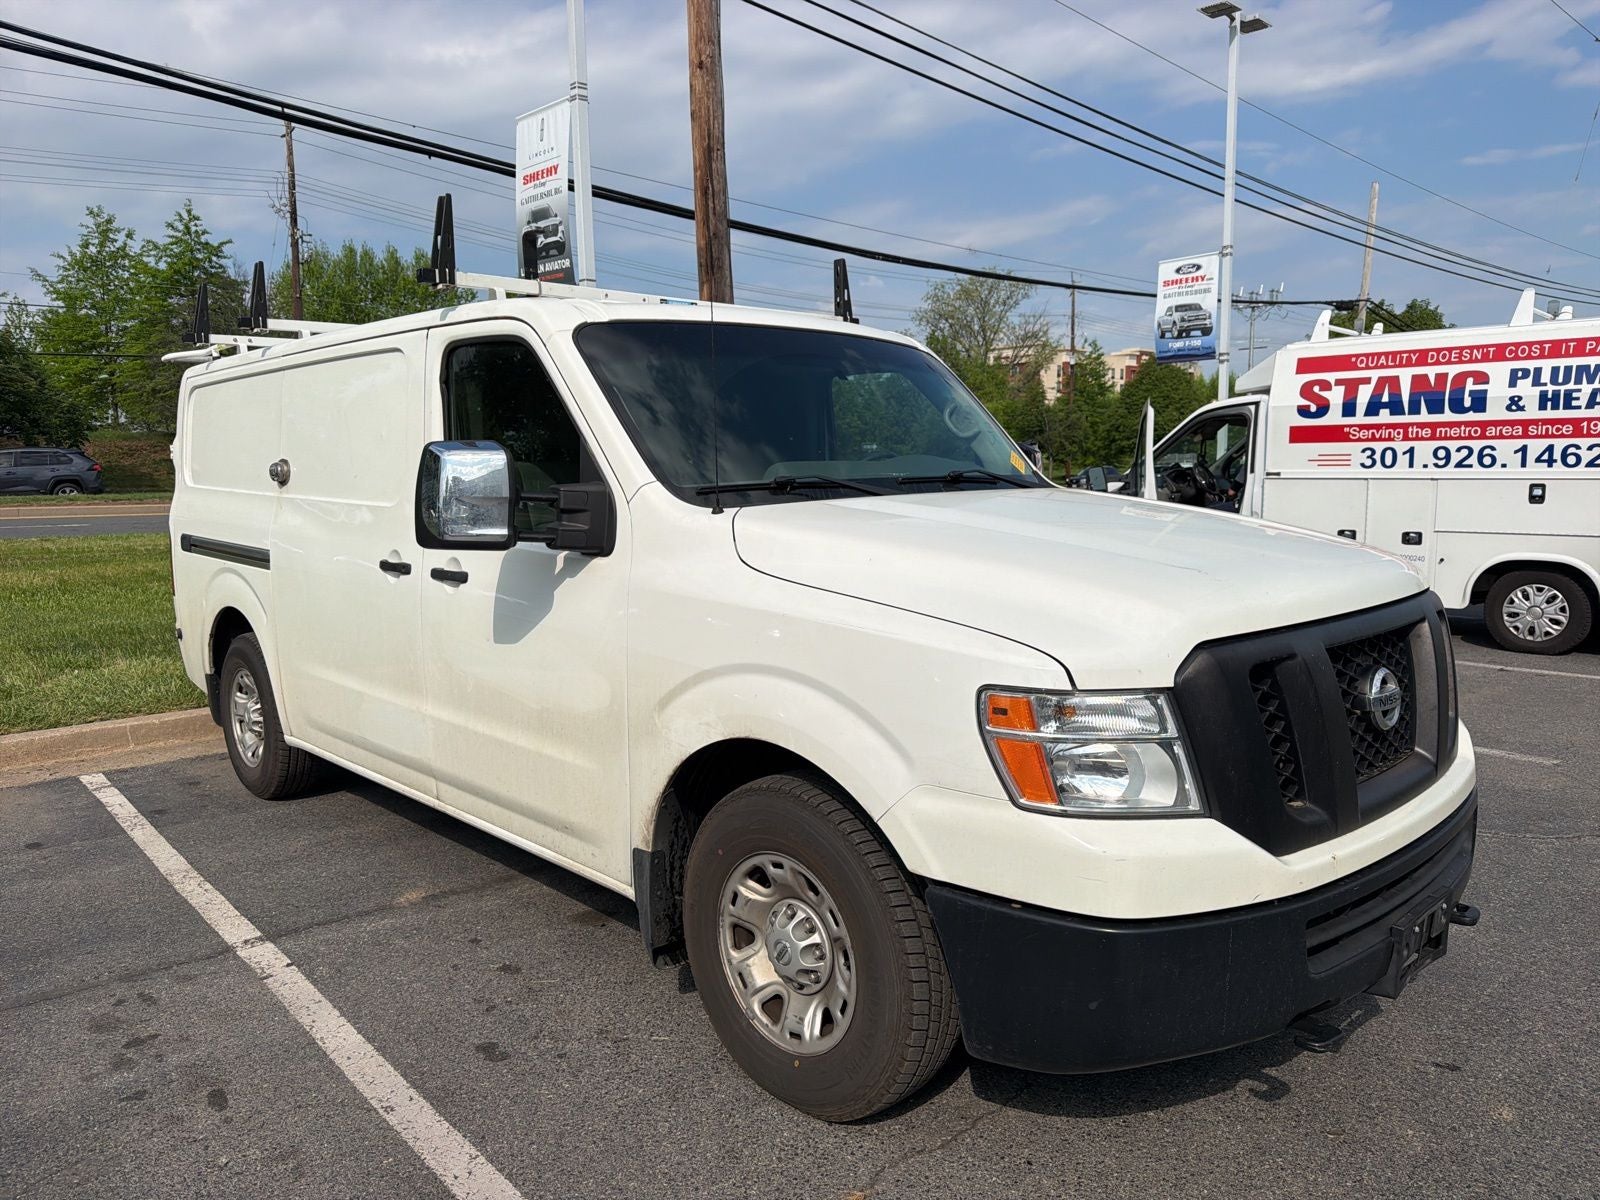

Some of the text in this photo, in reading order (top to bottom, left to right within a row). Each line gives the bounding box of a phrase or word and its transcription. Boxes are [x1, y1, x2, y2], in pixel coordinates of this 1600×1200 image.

[528, 146, 554, 161] LINCOLN
[522, 163, 560, 186] SHEEHY
[520, 186, 563, 206] GAITHERSBURG
[545, 258, 571, 272] AVIATOR
[1163, 287, 1212, 299] GAITHERSBURG
[1168, 339, 1202, 349] FORD F-150
[1351, 352, 1419, 368] "QUALITY
[1427, 347, 1496, 363] DOESN'T
[1505, 343, 1552, 358] COST
[1561, 341, 1577, 355] IT
[1508, 363, 1600, 388] PLUM
[1296, 370, 1490, 419] STANG
[1505, 394, 1526, 412] &
[1343, 426, 1404, 441] "Serving
[1408, 425, 1431, 438] the
[1436, 423, 1481, 437] metro
[1485, 425, 1522, 436] area
[1528, 421, 1573, 435] since
[1359, 443, 1600, 469] 301.926.1462
